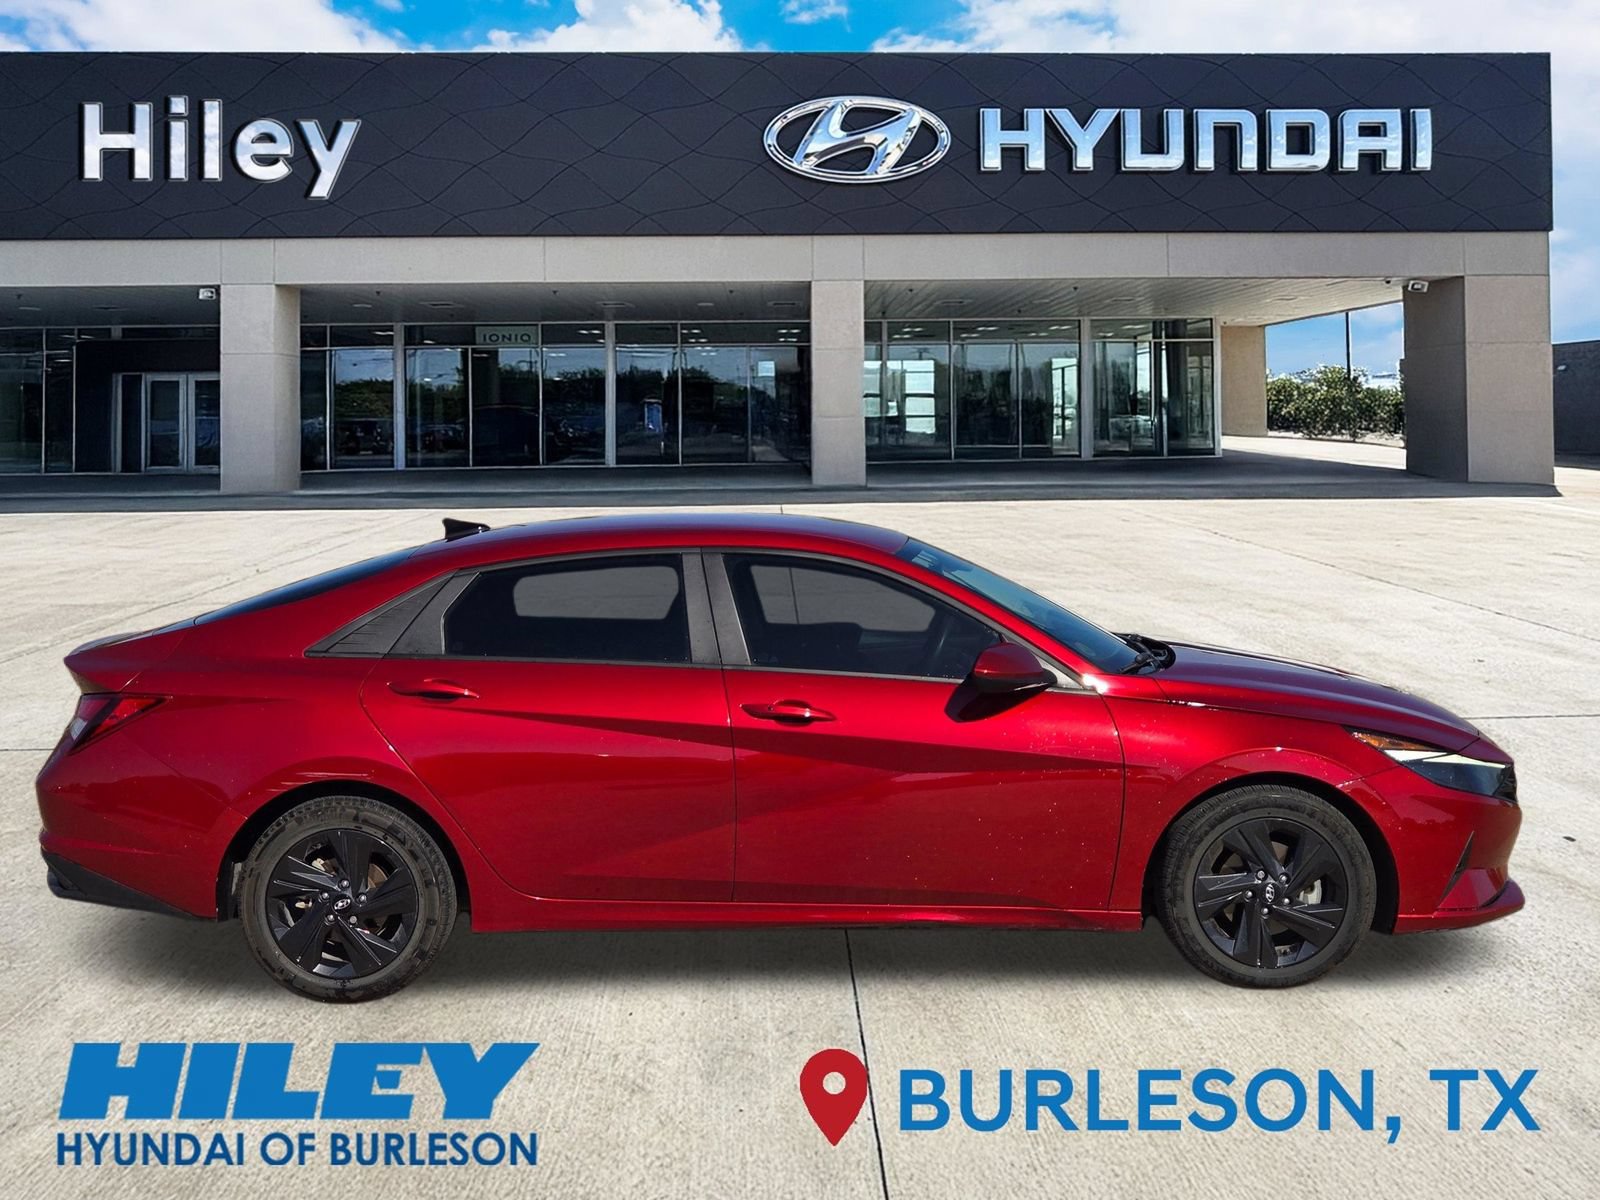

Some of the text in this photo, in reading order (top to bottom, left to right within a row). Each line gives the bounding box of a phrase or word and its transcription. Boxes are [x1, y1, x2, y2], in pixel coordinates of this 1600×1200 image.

[81, 95, 361, 199] Hiley
[980, 107, 1432, 172] HYUNDAI
[483, 333, 532, 343] IONIQ
